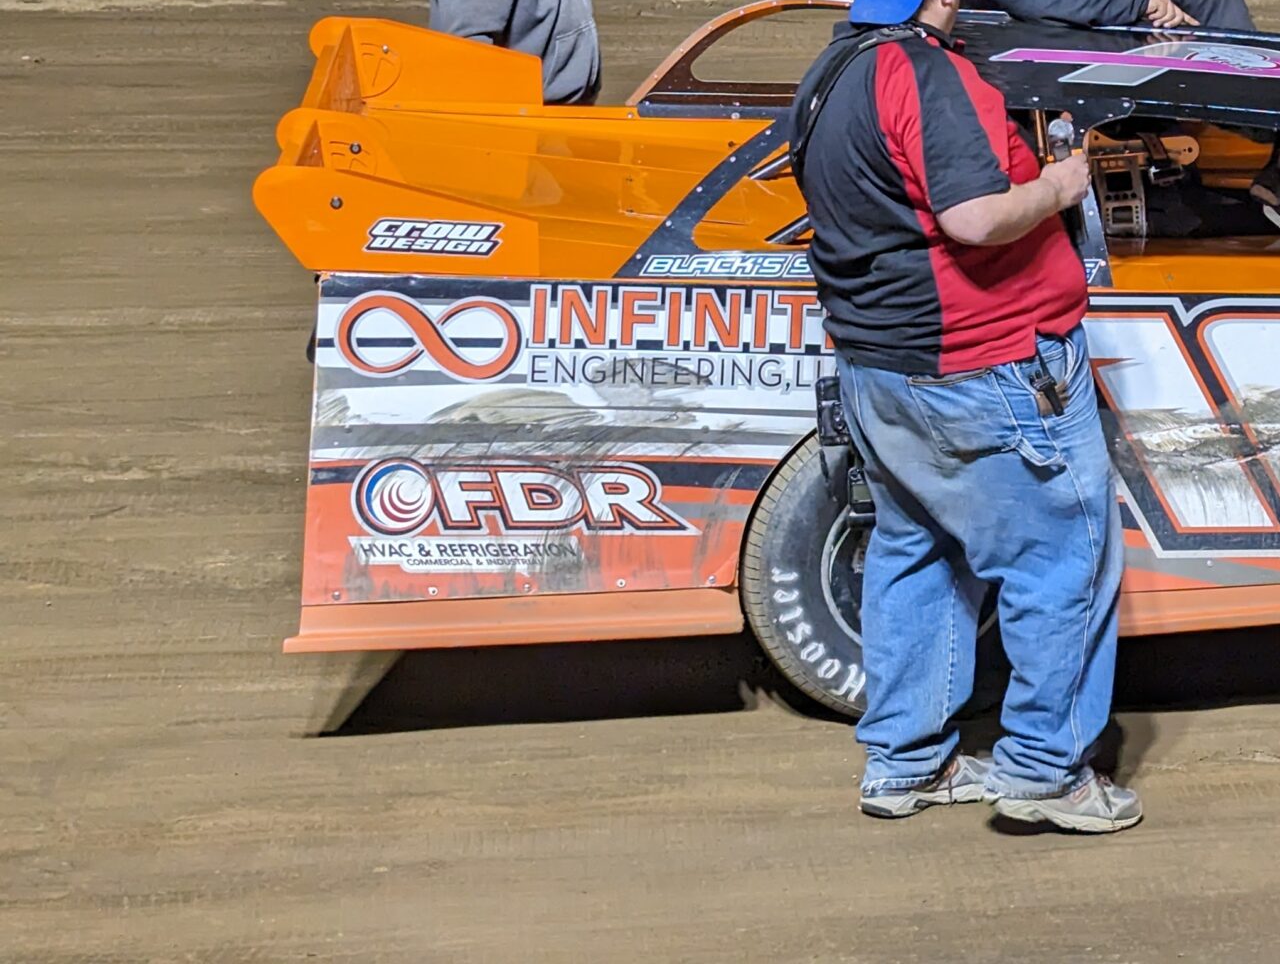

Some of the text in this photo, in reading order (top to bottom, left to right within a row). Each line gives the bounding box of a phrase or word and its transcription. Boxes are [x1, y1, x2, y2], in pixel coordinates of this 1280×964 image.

[368, 237, 495, 253] DESIGN
[645, 255, 787, 275] BLACK'S
[531, 287, 835, 350] INFINIT
[436, 466, 684, 528] FDR
[360, 542, 578, 558] HVAC & REFRIGERATION
[406, 558, 545, 567] COMMERCIAL & INDUSTRIAL
[771, 566, 866, 703] Hoosier
